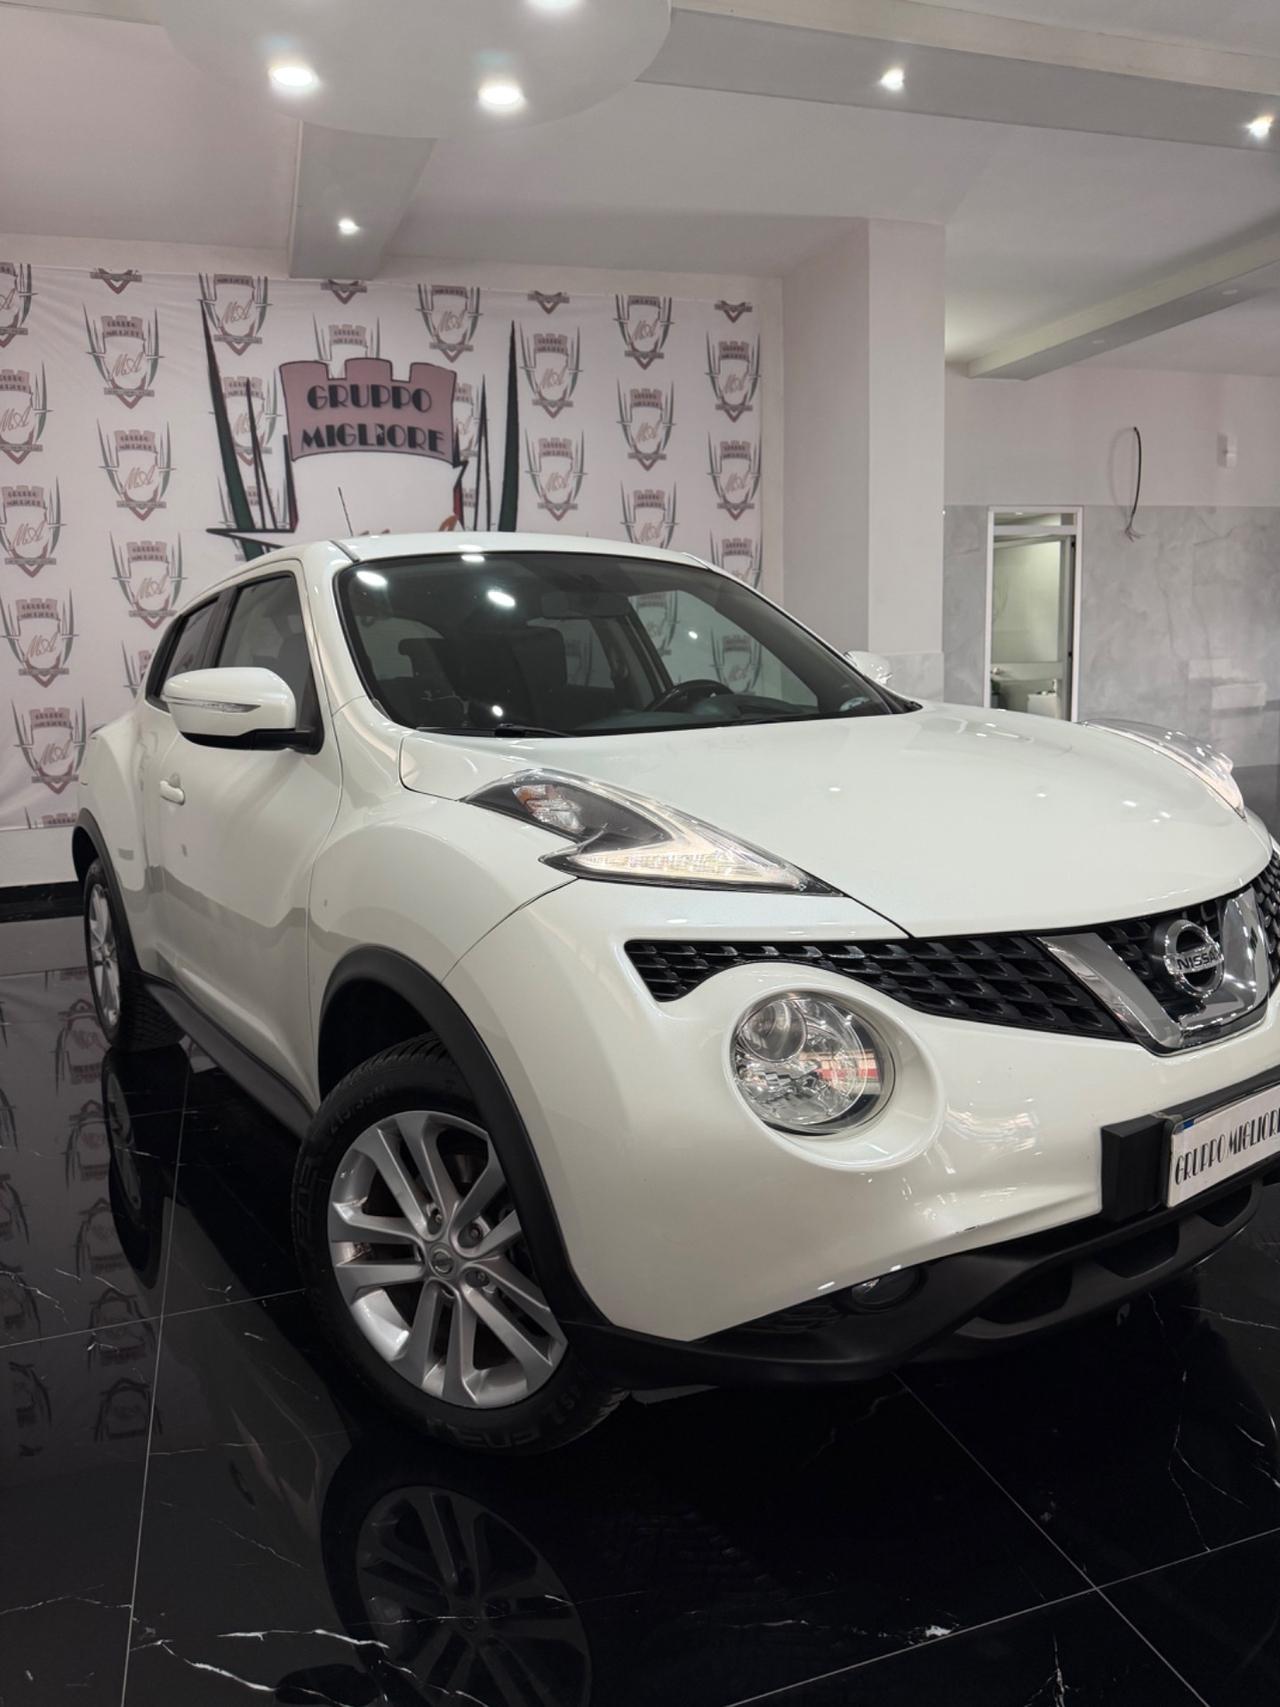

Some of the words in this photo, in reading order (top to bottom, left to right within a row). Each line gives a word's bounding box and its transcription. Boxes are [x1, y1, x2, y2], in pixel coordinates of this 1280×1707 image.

[307, 384, 432, 413] GRUPPO
[301, 422, 446, 456] MIGLIORE
[1175, 1134, 1226, 1185] GRUPPO
